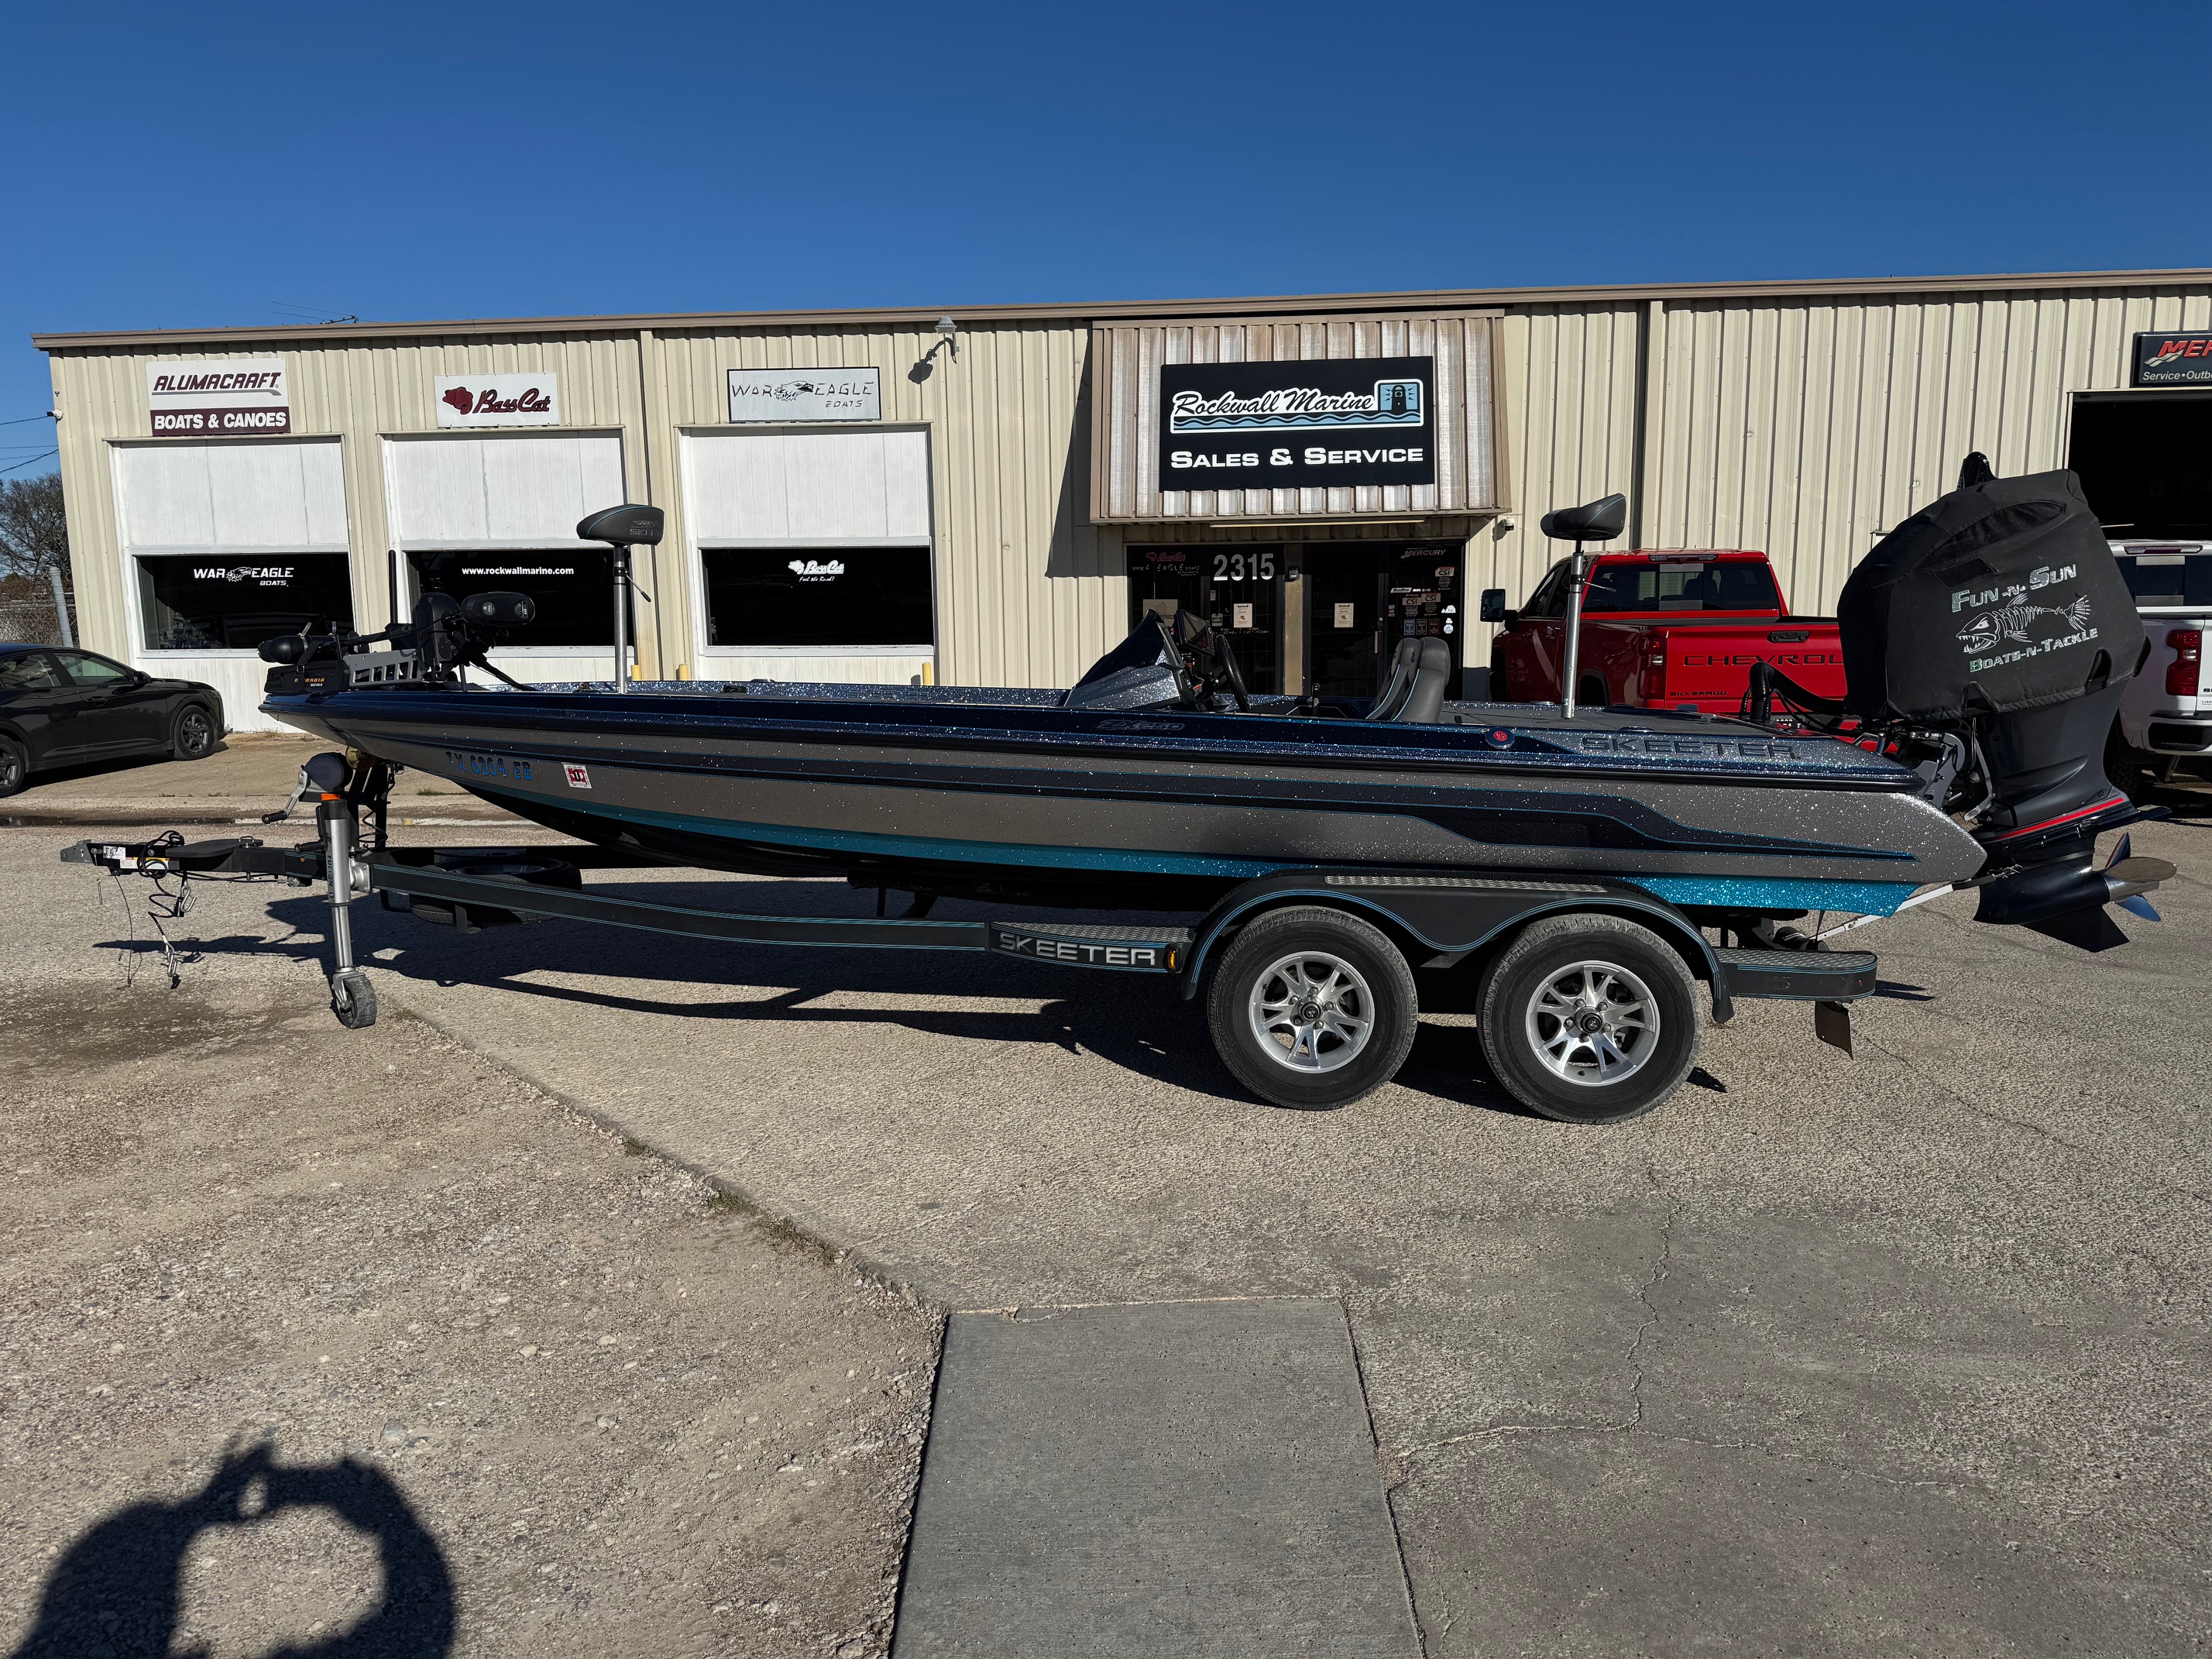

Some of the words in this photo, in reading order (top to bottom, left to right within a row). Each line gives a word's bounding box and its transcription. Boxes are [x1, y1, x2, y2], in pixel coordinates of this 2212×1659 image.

[153, 372, 282, 391] ALUMACRAFT
[2186, 369, 2212, 380] Outb
[731, 384, 772, 398] WAR
[814, 381, 874, 397] EAGLE
[1174, 390, 1279, 415] Rockwall
[1283, 389, 1374, 412] Marine
[155, 414, 204, 430] BOATS
[208, 413, 220, 429] &
[223, 411, 287, 428] CANOES
[1269, 448, 1294, 466] &
[193, 568, 226, 579] WAR
[251, 567, 294, 578] EAGLE
[462, 566, 575, 575] www.rockwallmarine.com
[1213, 552, 1275, 582] 2315
[1683, 654, 1845, 667] CHEVROL
[1581, 736, 1797, 760] SKEETER
[445, 751, 467, 772] TX
[470, 754, 507, 778] 6264
[999, 932, 1156, 966] SKEETER
